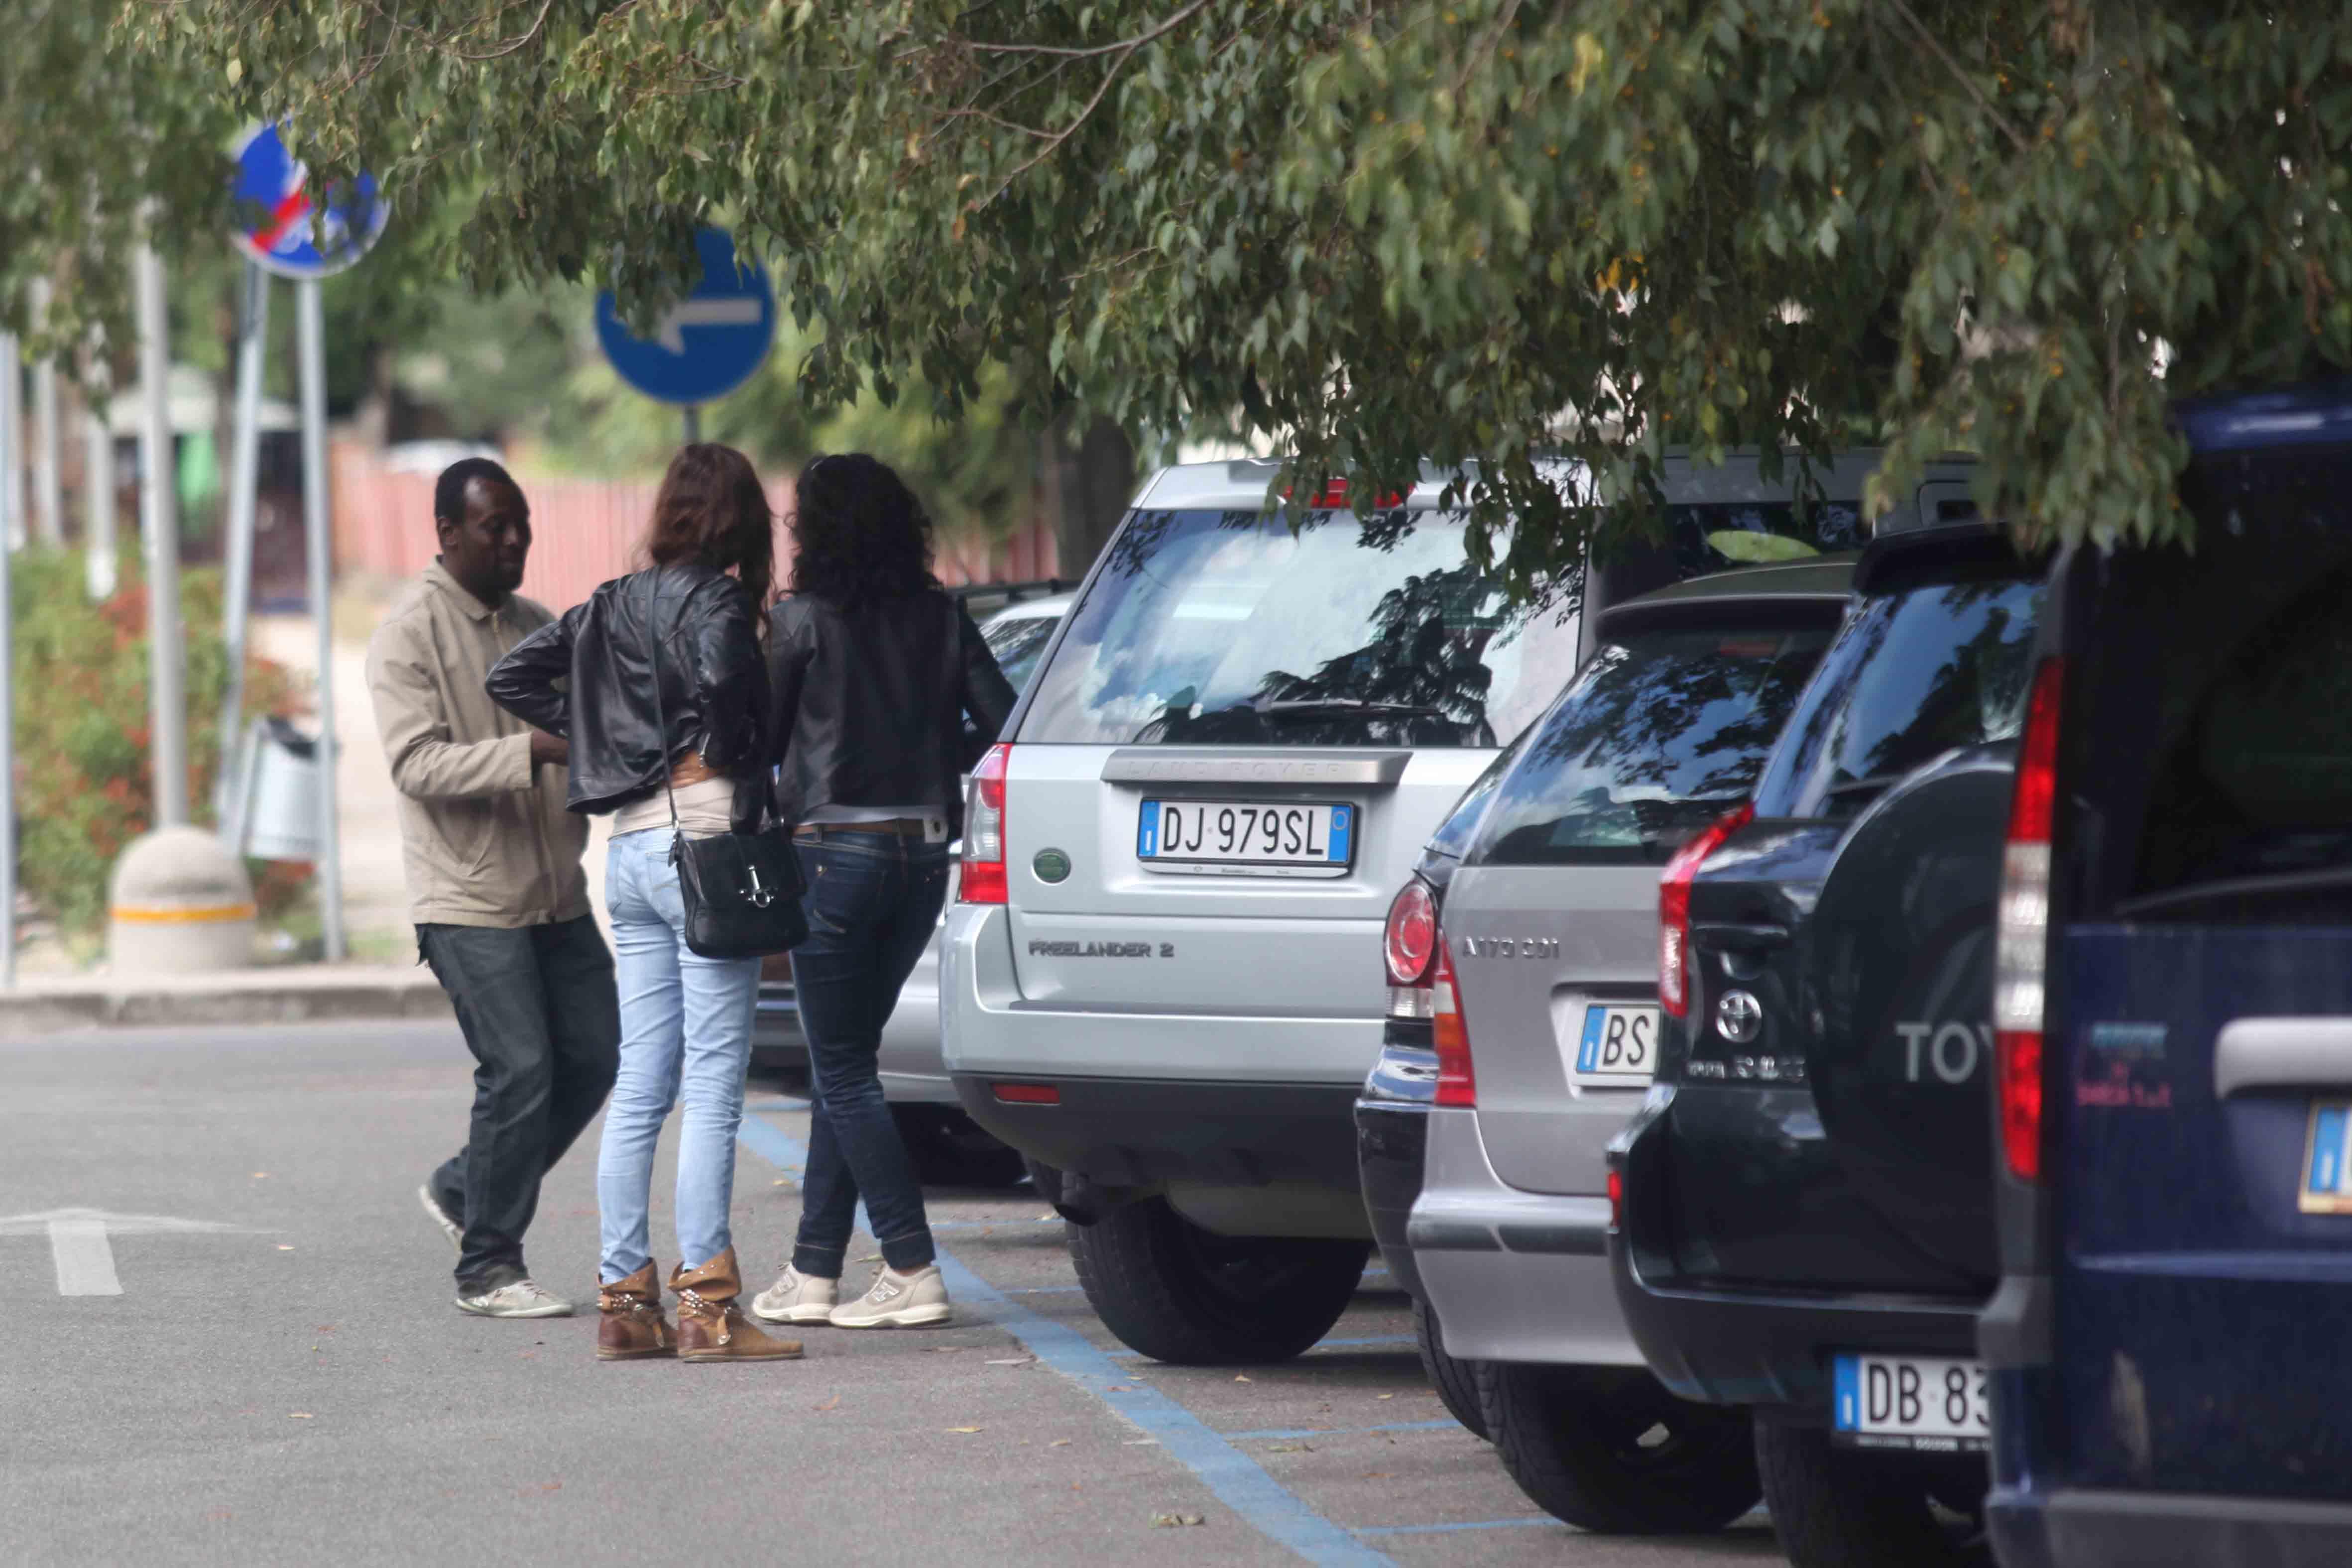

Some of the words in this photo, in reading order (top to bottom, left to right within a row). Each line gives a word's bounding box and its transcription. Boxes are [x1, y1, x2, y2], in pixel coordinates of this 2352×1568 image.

[1163, 807, 1204, 852] DJ
[1218, 808, 1324, 856] 979SL
[1028, 940, 1152, 958] FREELANDER
[1159, 942, 1175, 958] 2
[1602, 1014, 1650, 1066] BS
[1869, 1364, 1921, 1424] DB
